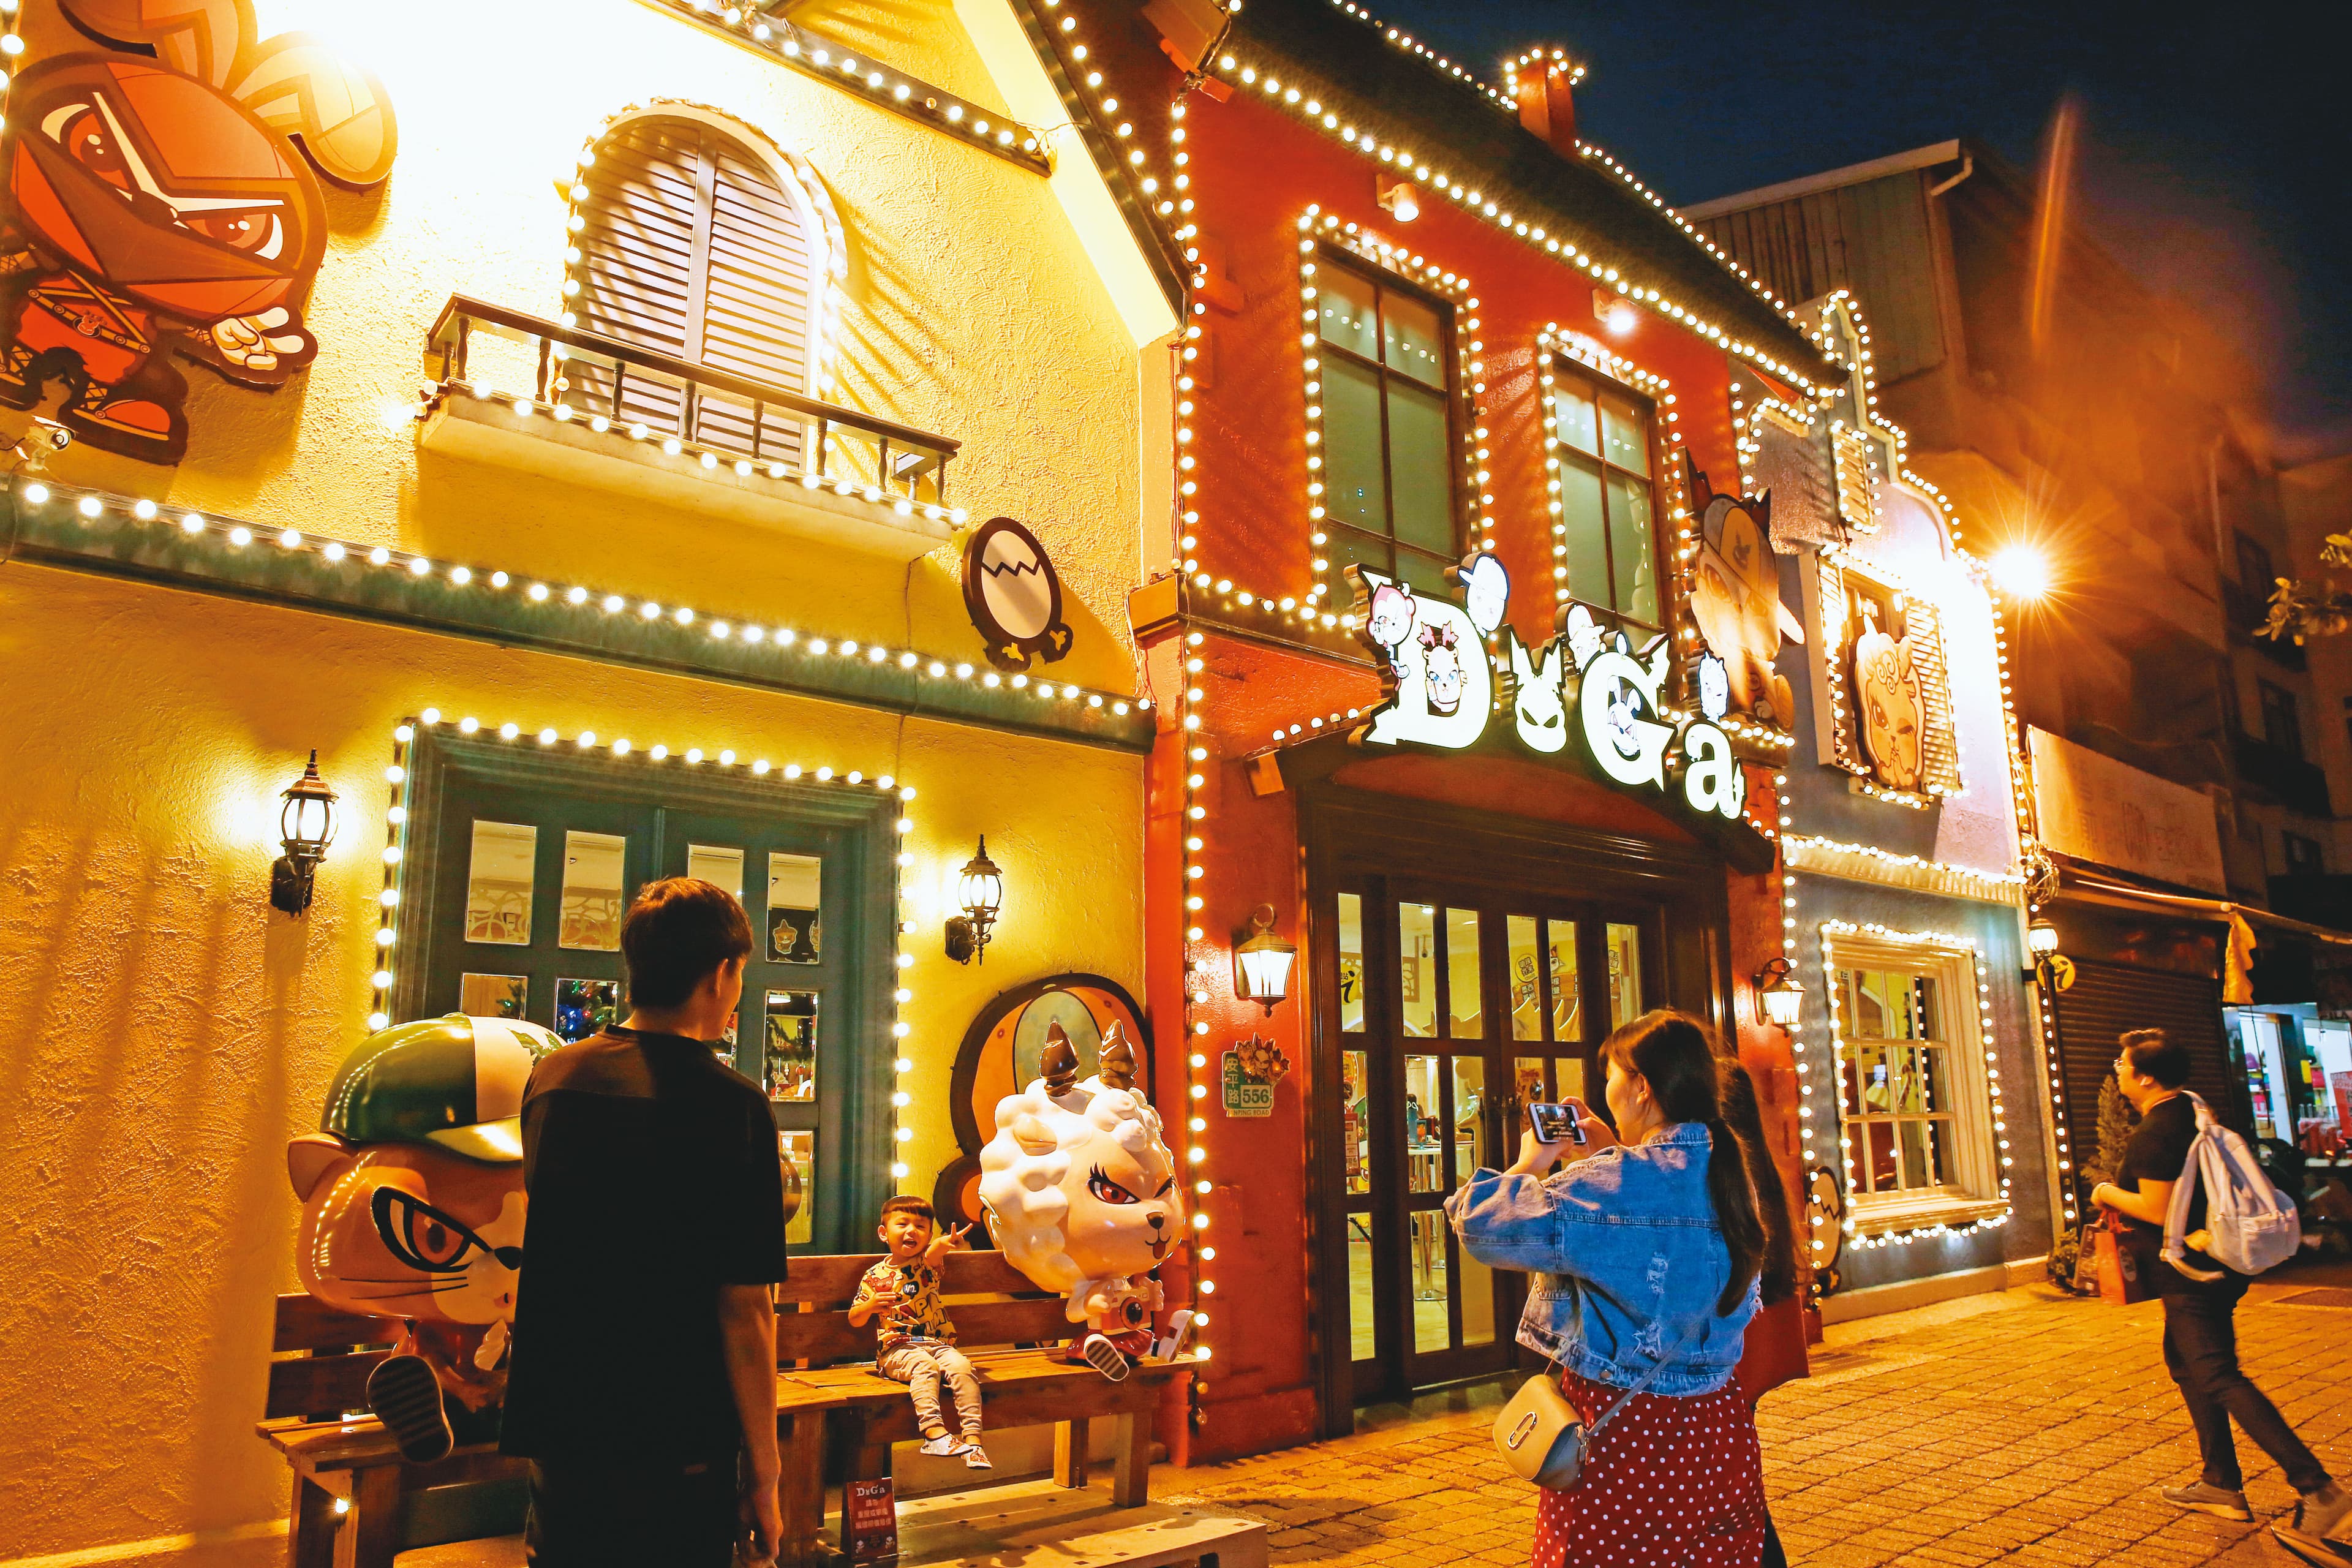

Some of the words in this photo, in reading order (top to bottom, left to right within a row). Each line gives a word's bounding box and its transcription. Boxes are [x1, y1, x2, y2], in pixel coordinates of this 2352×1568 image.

[1227, 1057, 1240, 1104] 安平路
[1242, 1088, 1270, 1104] 556
